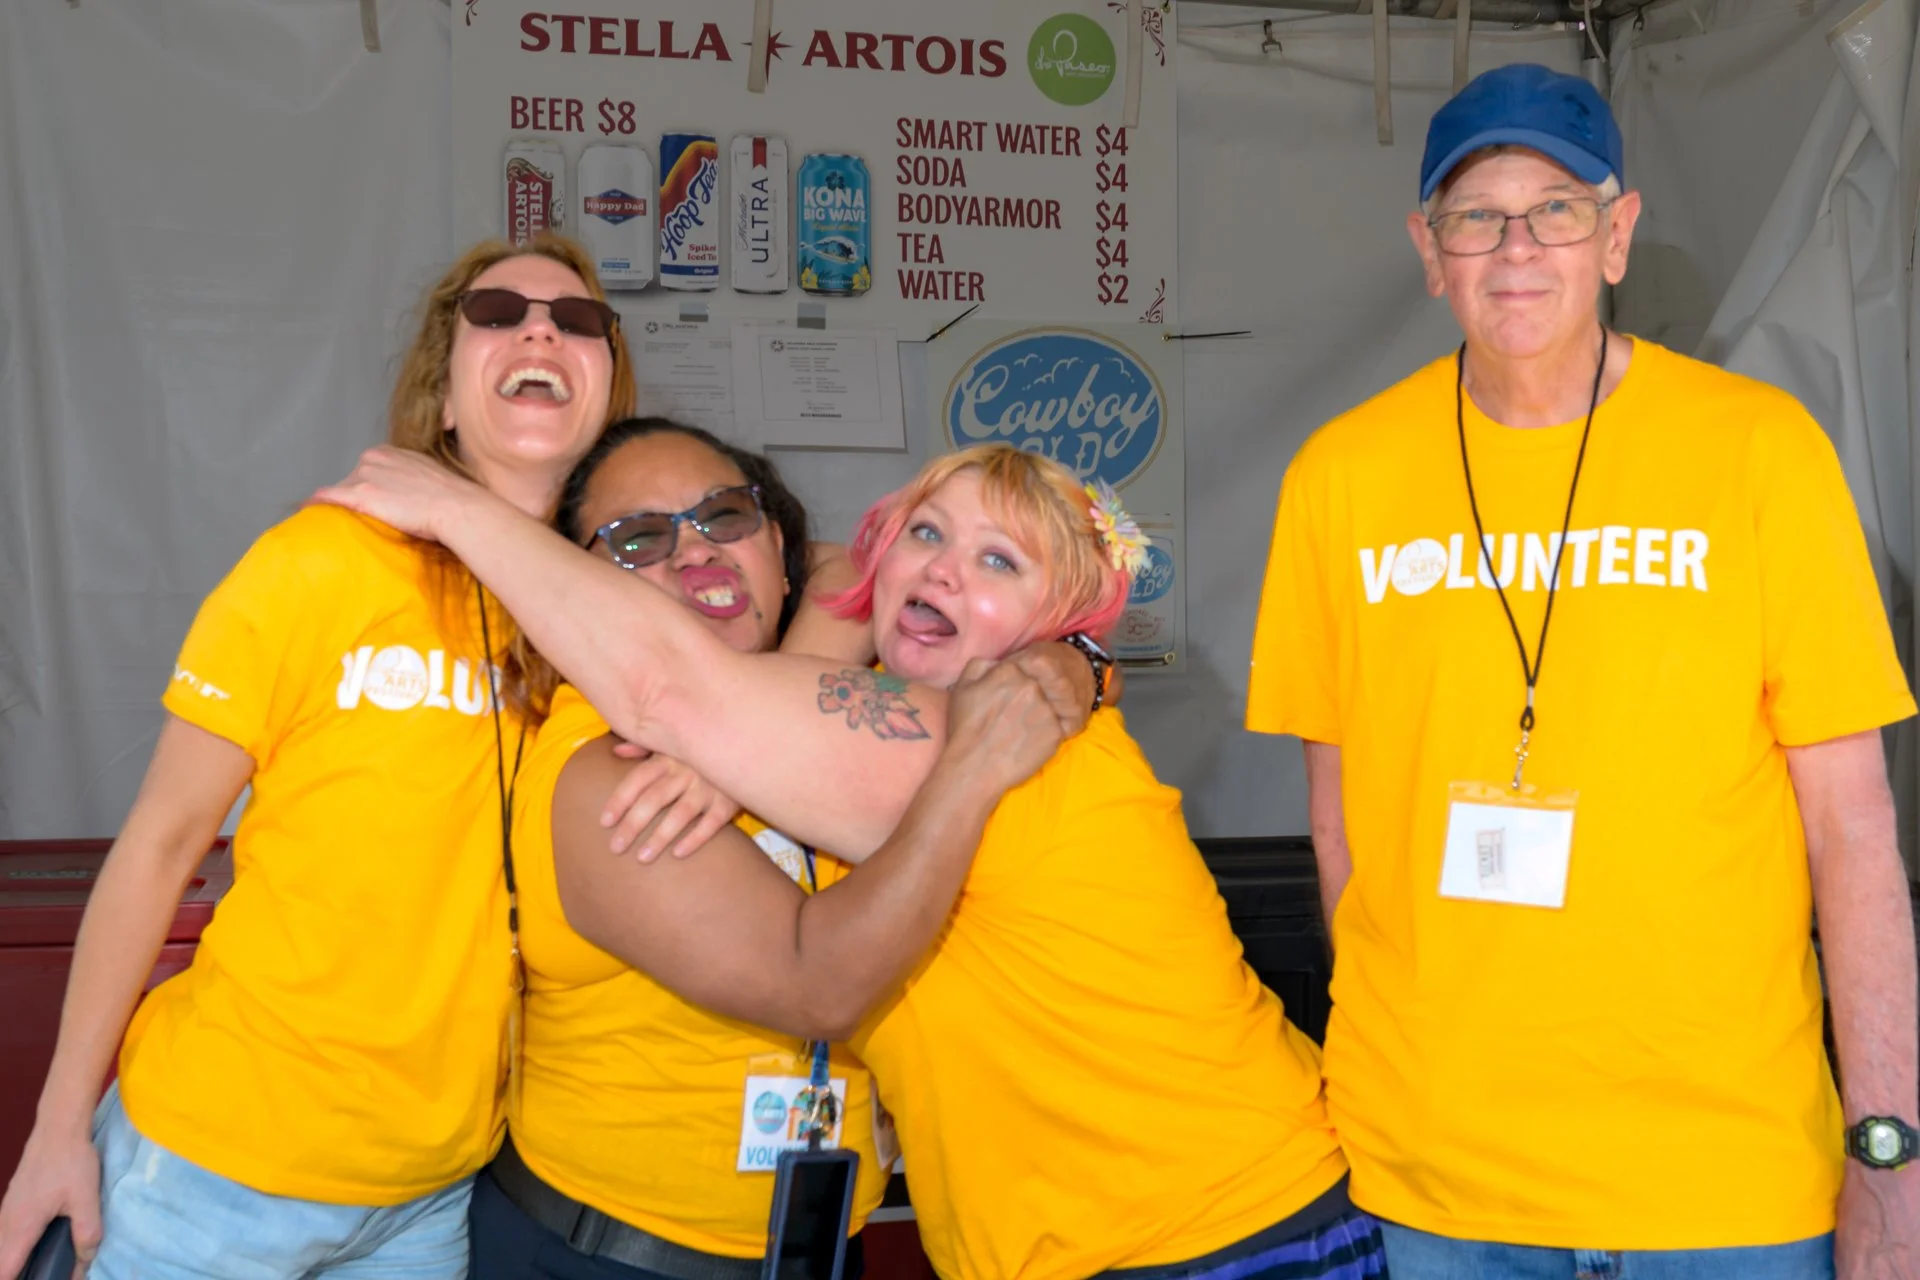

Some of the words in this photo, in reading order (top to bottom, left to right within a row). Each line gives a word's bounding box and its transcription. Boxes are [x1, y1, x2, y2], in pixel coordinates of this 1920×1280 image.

[520, 11, 733, 62] STELLA
[801, 29, 1007, 78] ARTOIS
[510, 95, 585, 133] BEER
[597, 98, 637, 136] $8
[896, 117, 987, 152] SMART
[995, 122, 1082, 156] WATER
[1095, 123, 1128, 156] $4
[896, 155, 967, 188] SODA
[1095, 160, 1128, 193] $4
[515, 180, 528, 249] ARTOIS
[529, 181, 544, 240] STELL
[586, 201, 622, 212] Happy
[624, 202, 645, 211] Dad
[803, 186, 865, 209] KONA
[803, 207, 826, 221] BIG
[897, 192, 1061, 230] BODYARMOR
[1095, 200, 1128, 232] $4
[661, 203, 704, 261] Hoop
[752, 177, 769, 263] ULTRA
[897, 232, 944, 264] TEA
[1095, 236, 1128, 269] $4
[897, 268, 985, 301] WATER
[1097, 271, 1129, 304] $2
[959, 364, 1158, 459] Cowboy
[1359, 525, 1709, 604] VOLUNTEER
